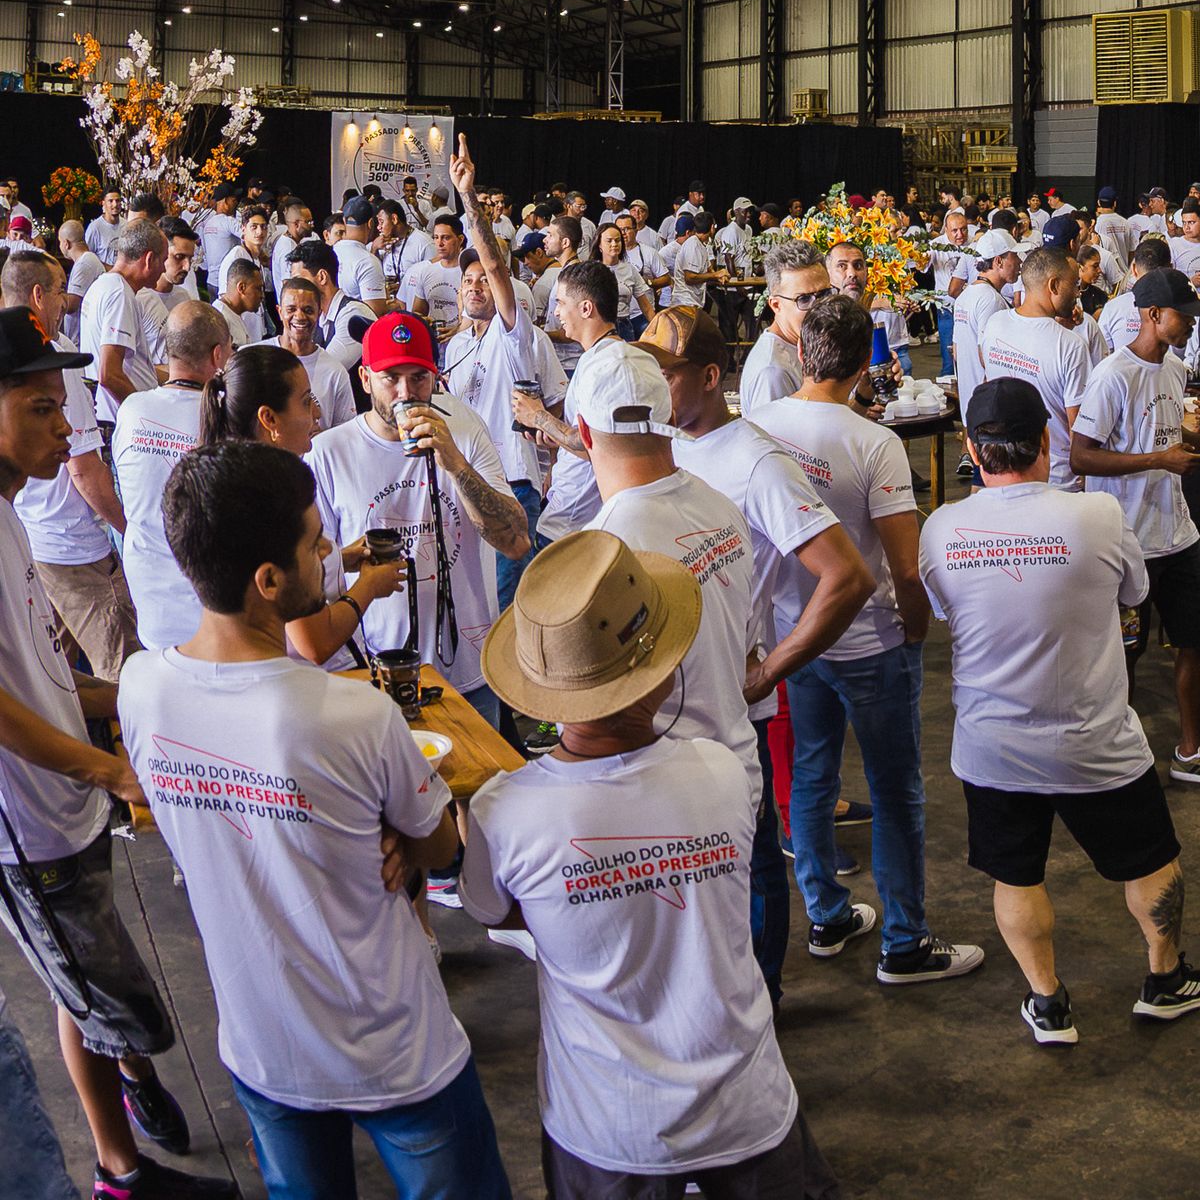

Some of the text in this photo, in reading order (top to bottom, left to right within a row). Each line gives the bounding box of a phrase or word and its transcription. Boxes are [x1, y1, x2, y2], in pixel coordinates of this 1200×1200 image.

[364, 128, 399, 143] PASSADO
[408, 135, 432, 169] PRESENTE
[368, 172, 394, 182] 360°
[369, 162, 415, 173] FUNDIMIG
[988, 352, 1004, 361] FORÇA
[1012, 358, 1041, 373] PRESENTE,
[1000, 361, 1014, 370] PARA
[131, 436, 154, 447] FORÇA
[156, 439, 169, 448] NO
[151, 447, 171, 457] PARA
[798, 452, 831, 471] PASSADO,
[374, 479, 416, 504] PASSADO
[945, 535, 1066, 552] ORGULHO DO PASSADO,
[946, 545, 1071, 561] FORÇA NO PRESENTE,
[946, 556, 1070, 571] OLHAR PARA O FUTURO.
[148, 757, 302, 793] ORGULHO DO PASSADO,
[151, 774, 313, 811] FORÇA NO PRESENTE,
[155, 790, 313, 823] OLHAR PARA O FUTURO.
[561, 831, 733, 879] ORGULHO DO PASSADO,
[565, 845, 740, 894] FORÇA NO PRESENTE,
[568, 862, 737, 906] OLHAR PARA O FUTURO.
